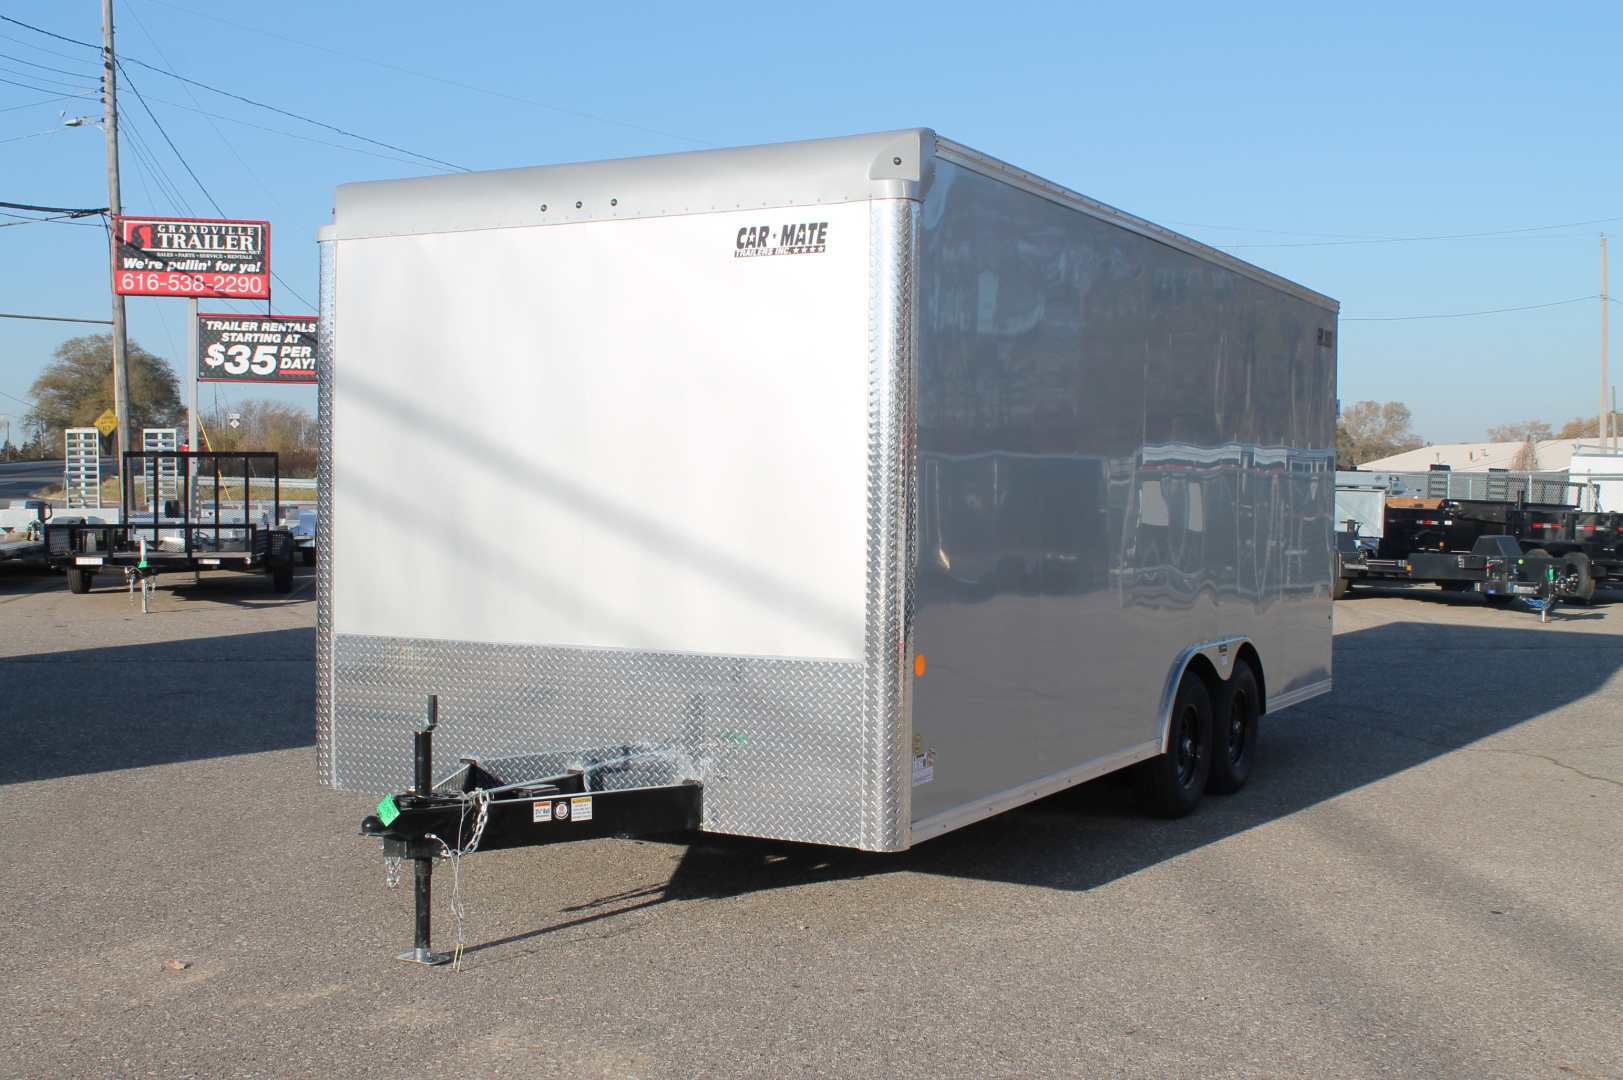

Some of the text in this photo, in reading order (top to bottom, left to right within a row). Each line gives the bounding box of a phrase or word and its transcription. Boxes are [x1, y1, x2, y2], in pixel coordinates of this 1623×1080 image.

[157, 224, 255, 235] GRANDVILLE
[736, 222, 828, 249] CAR MATE
[157, 233, 254, 250] TRAILER
[735, 247, 791, 257] TRAILERS INC.
[123, 257, 262, 274] We're pullin' for ya!
[122, 273, 262, 293] 616-538-2290
[206, 321, 317, 333] TRAILER RENTALS
[221, 332, 302, 344] STARTING AT
[205, 341, 312, 375] $35 PER
[280, 358, 316, 370] DAY!
